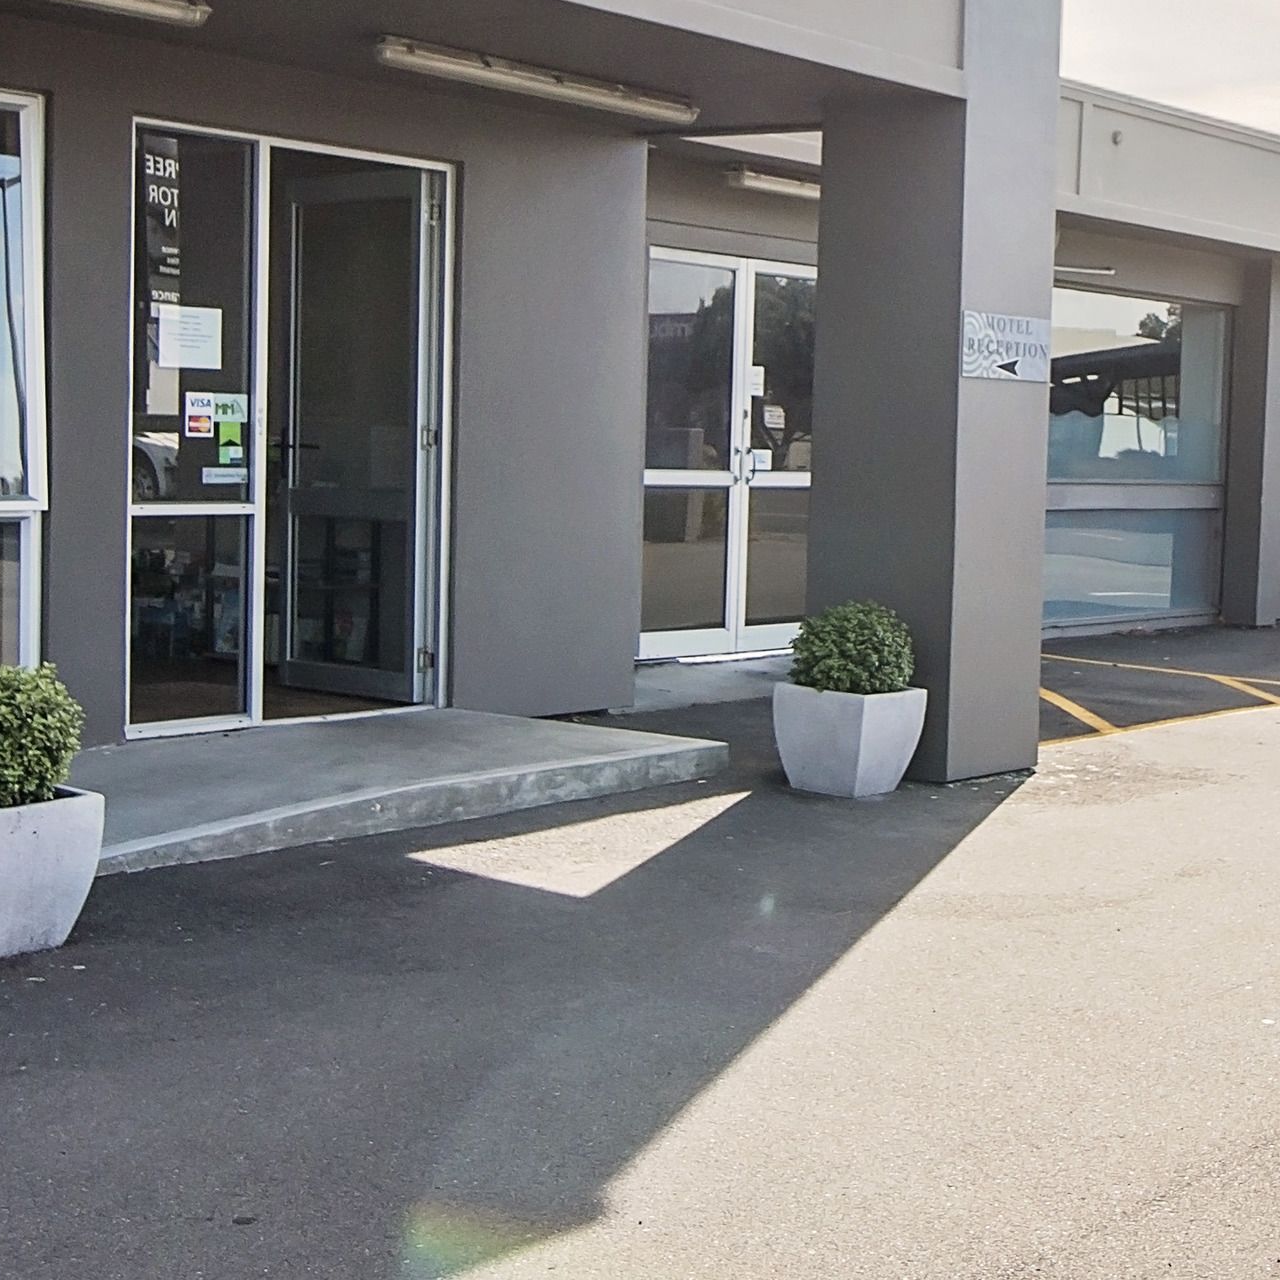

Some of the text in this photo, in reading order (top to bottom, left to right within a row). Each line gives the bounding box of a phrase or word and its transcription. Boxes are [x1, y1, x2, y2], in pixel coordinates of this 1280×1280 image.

[986, 315, 1033, 336] MOTEL
[967, 337, 1049, 360] RECEPTION
[190, 398, 212, 408] VISA
